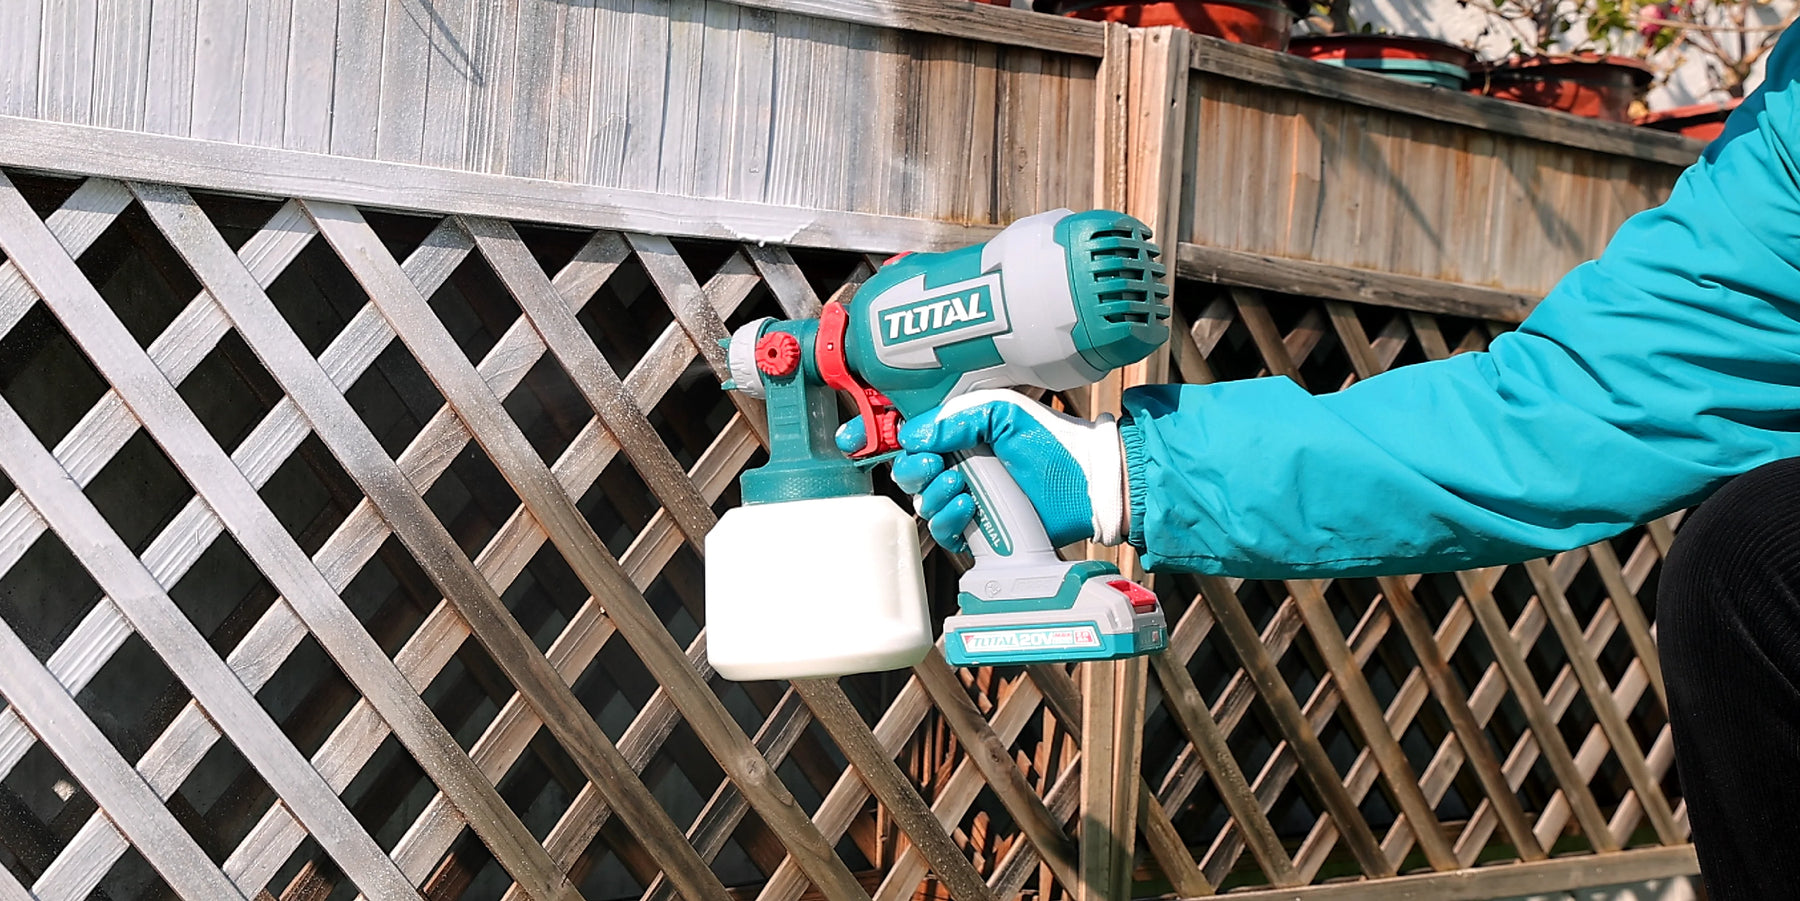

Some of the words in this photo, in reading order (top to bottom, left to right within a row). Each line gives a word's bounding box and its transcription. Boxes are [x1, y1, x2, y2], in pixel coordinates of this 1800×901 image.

[884, 292, 987, 339] TOTAL
[974, 635, 1015, 647] TOTAL
[1019, 632, 1052, 646] 20V
